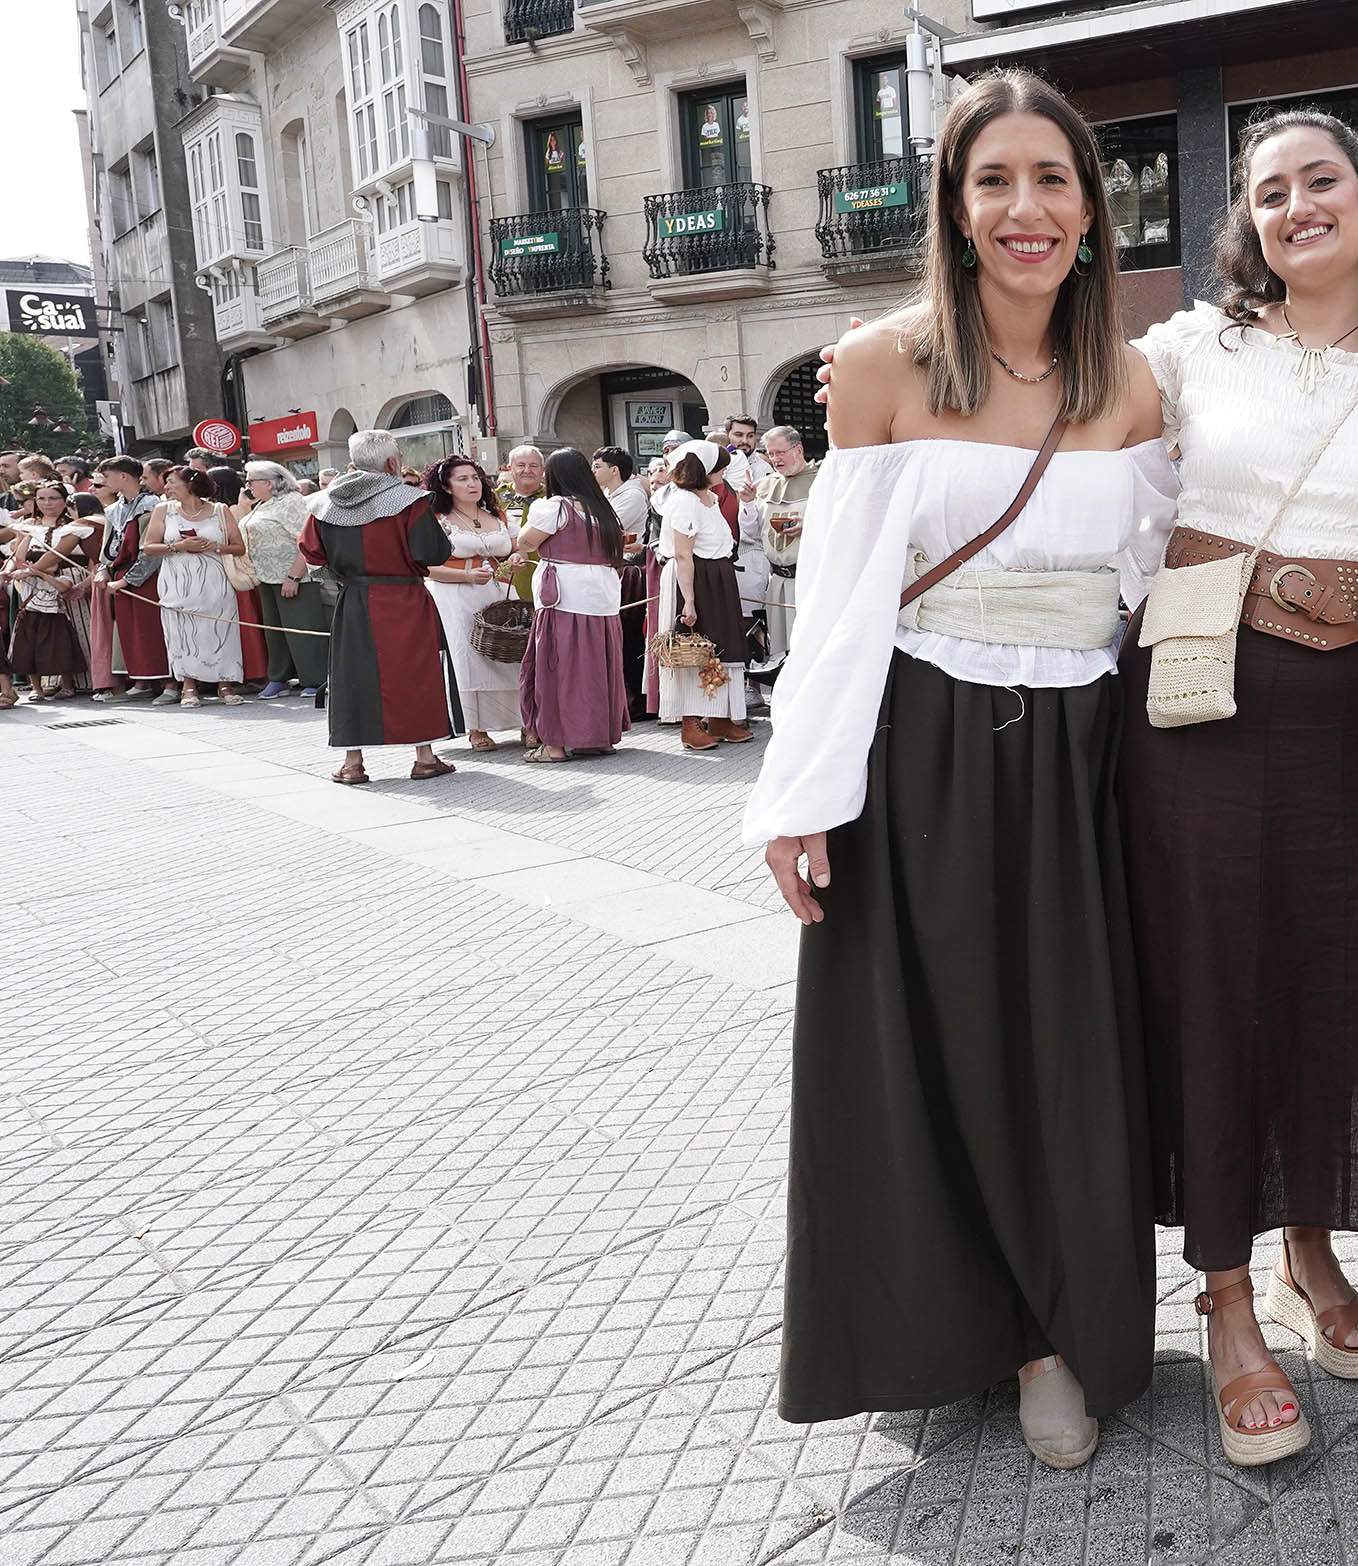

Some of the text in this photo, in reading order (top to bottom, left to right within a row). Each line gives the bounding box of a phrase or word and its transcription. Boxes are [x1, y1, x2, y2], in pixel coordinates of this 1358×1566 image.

[844, 187, 889, 202] 626 77 36 31
[851, 198, 883, 209] YDEAS.ES
[665, 213, 715, 234] YDEAS
[720, 365, 729, 383] 3
